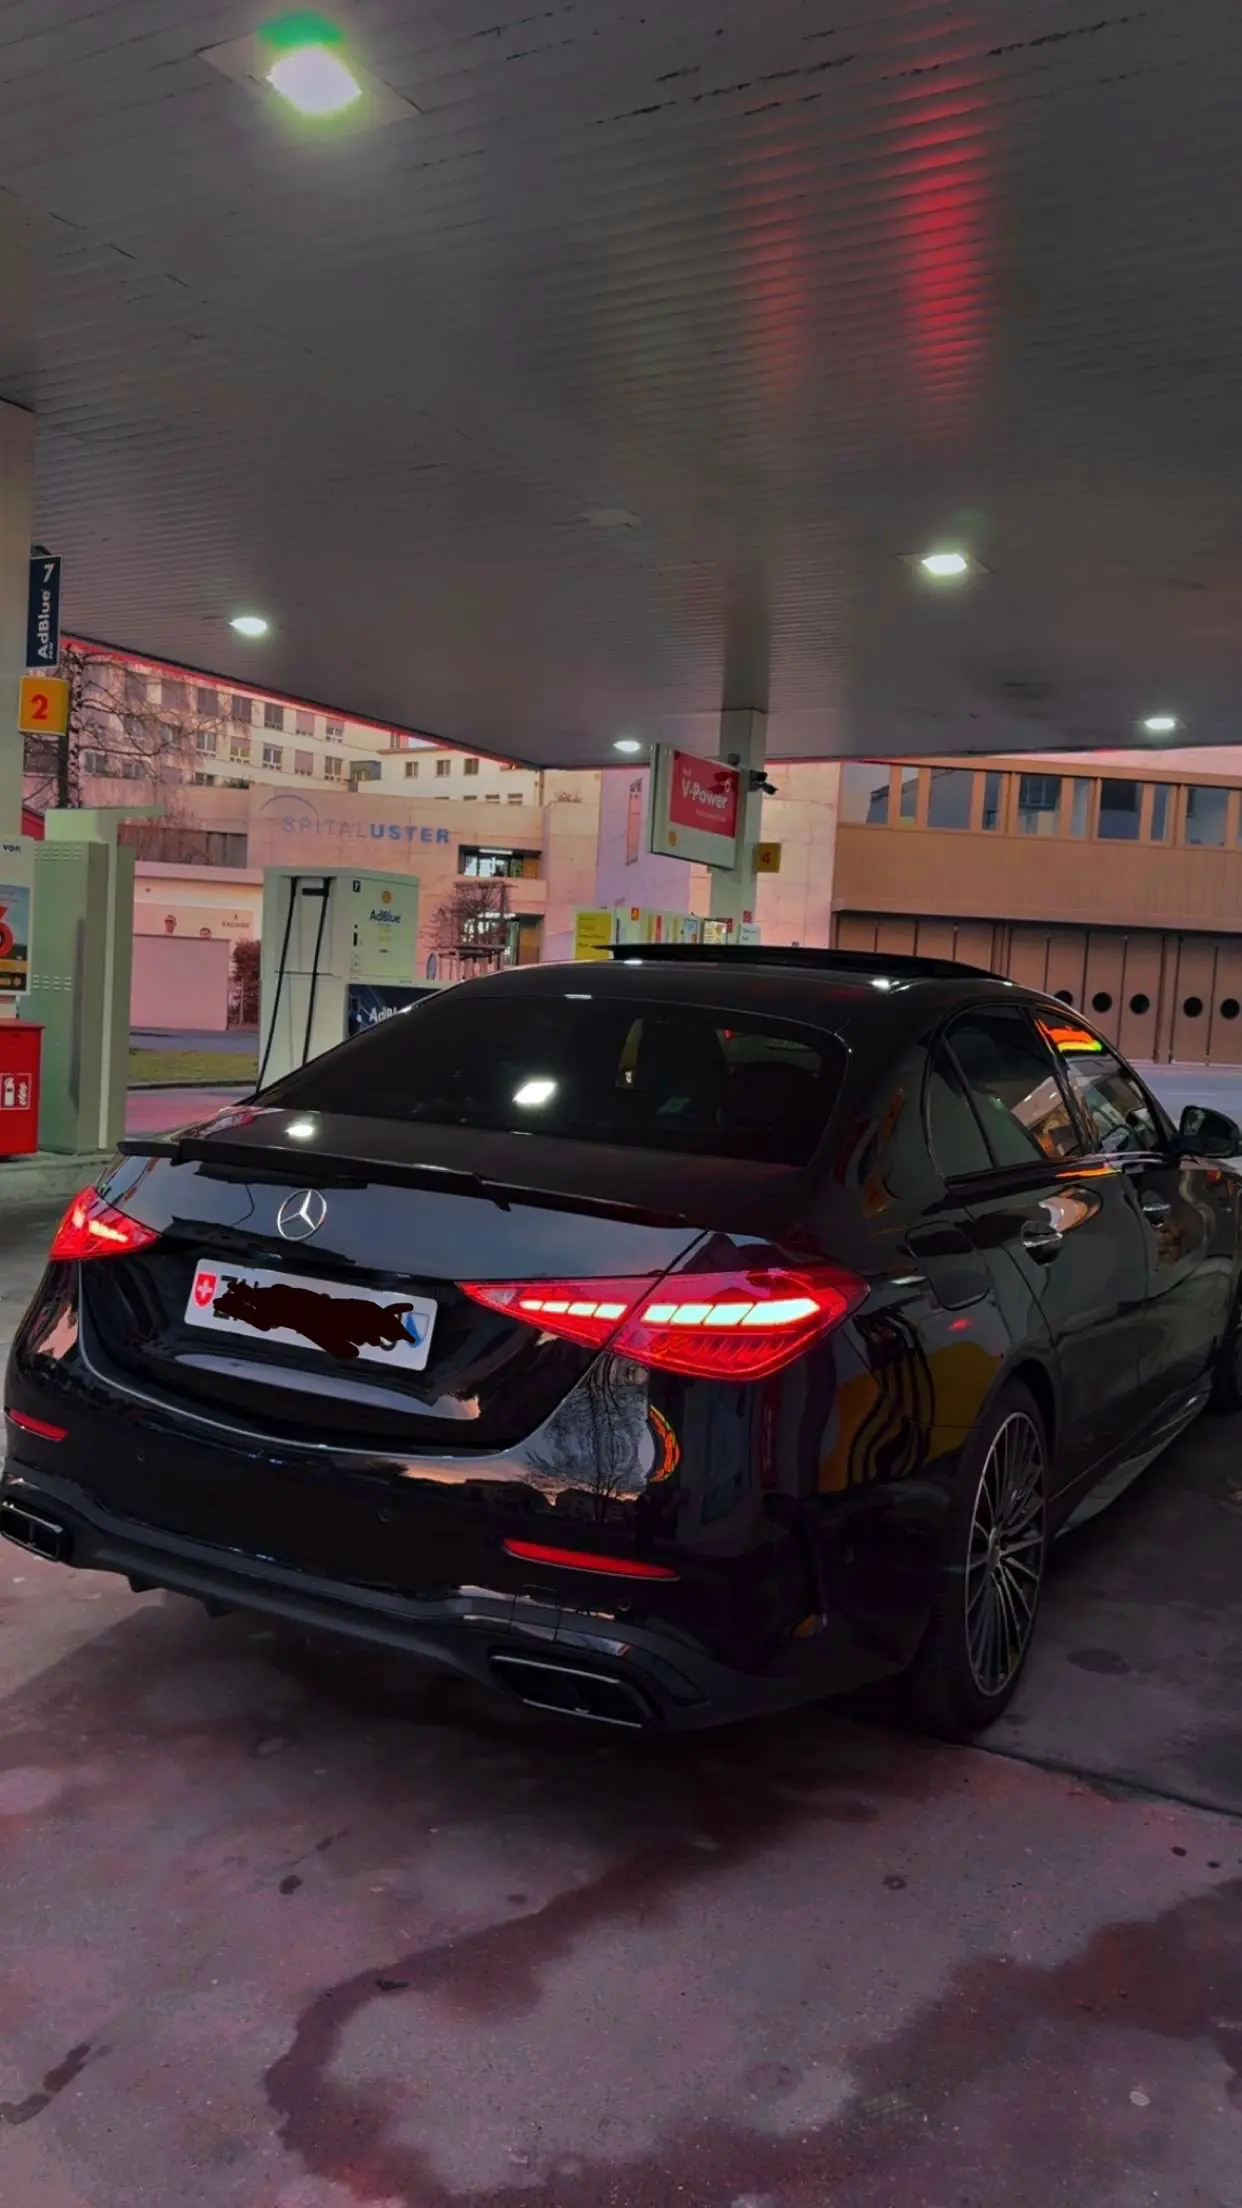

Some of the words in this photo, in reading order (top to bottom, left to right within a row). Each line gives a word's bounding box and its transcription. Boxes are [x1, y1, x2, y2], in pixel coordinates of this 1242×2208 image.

[43, 563, 54, 583] 7
[37, 590, 52, 660] AdBlue
[31, 694, 48, 721] 2
[681, 778, 729, 809] V-Power
[761, 851, 772, 864] 4
[369, 909, 402, 924] AdBlue
[369, 1006, 398, 1023] AdBl
